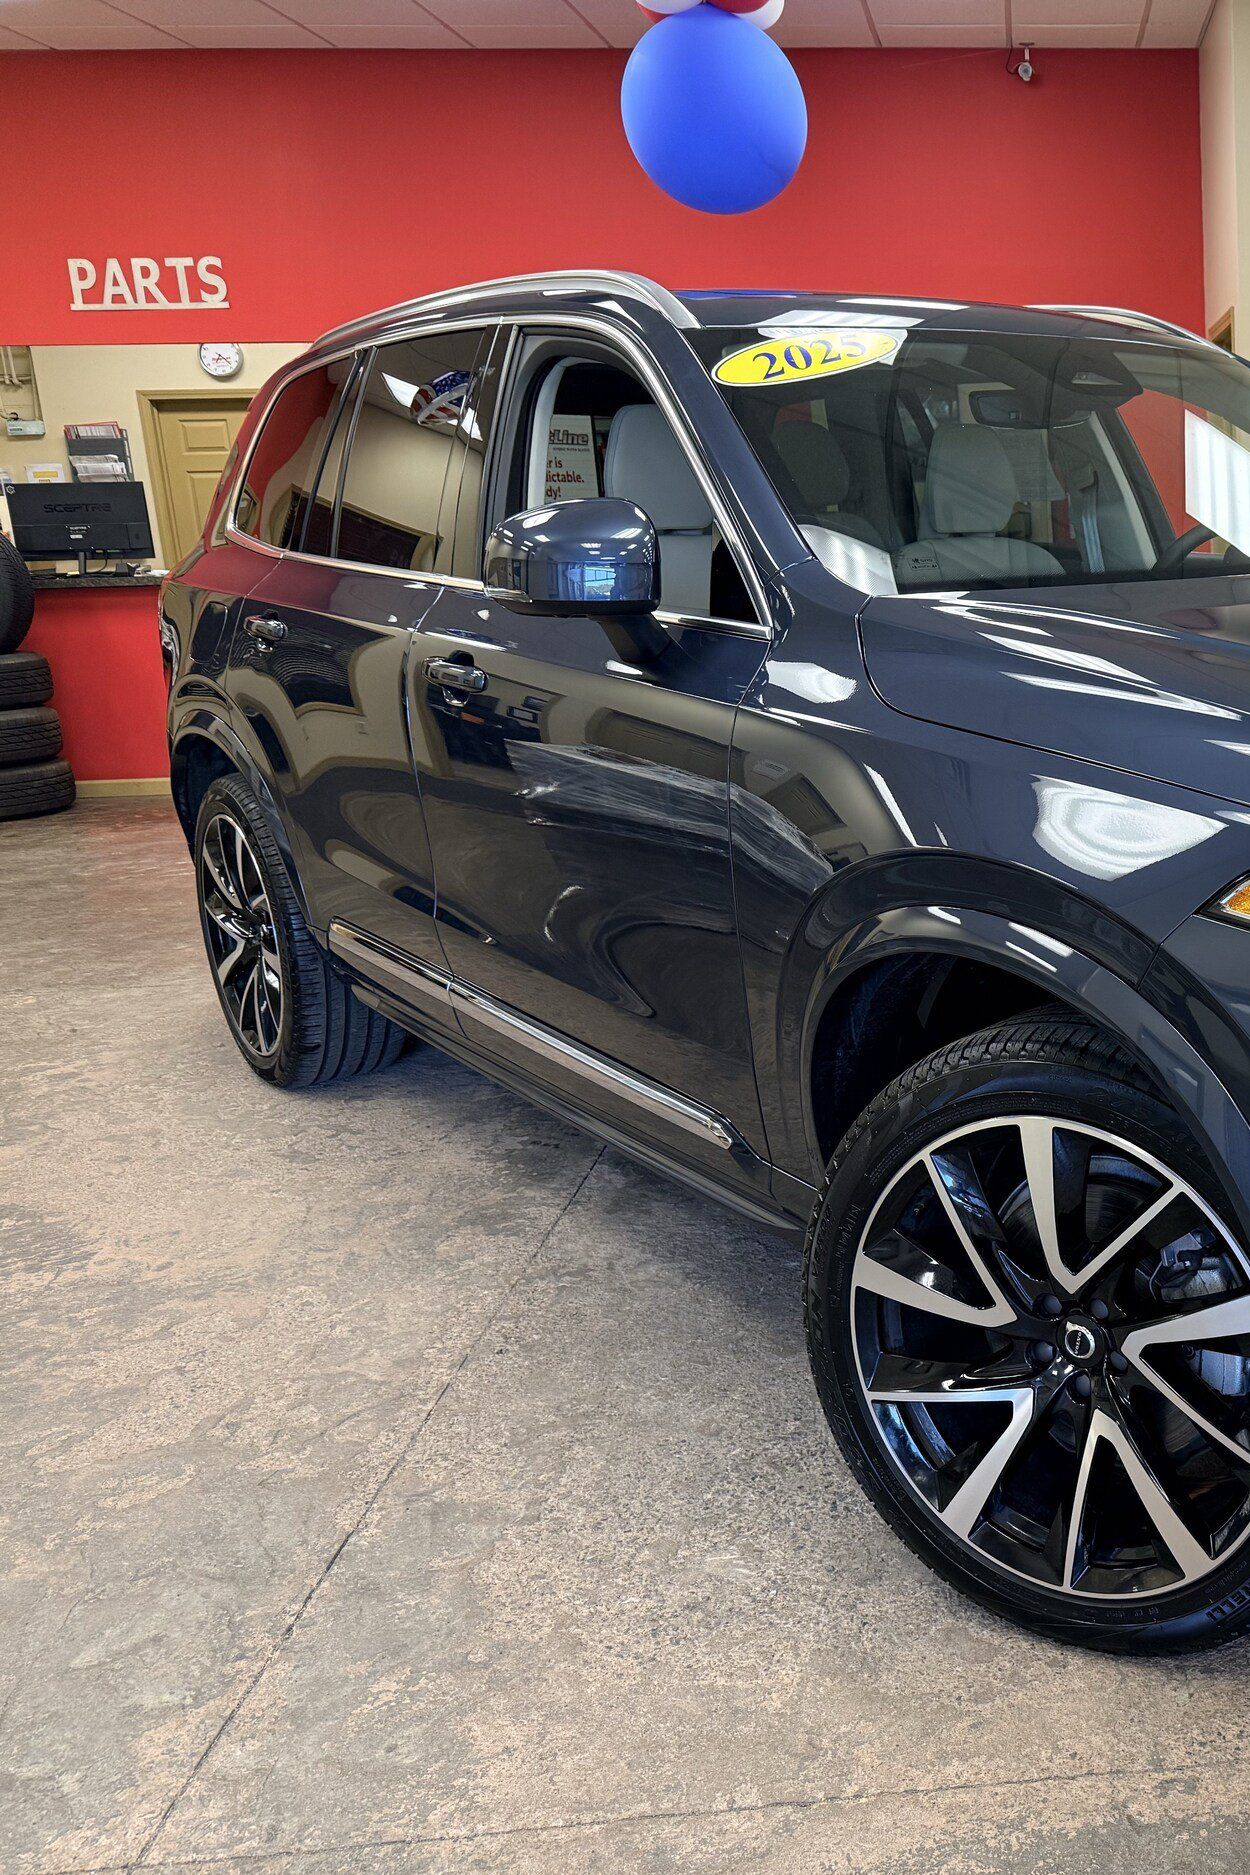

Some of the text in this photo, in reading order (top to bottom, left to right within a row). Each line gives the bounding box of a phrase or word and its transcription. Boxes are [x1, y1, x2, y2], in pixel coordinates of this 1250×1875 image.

[67, 255, 228, 305] PARTS
[752, 334, 866, 380] 2025
[554, 456, 563, 468] is
[43, 502, 112, 514] SCEPTRE
[1074, 1331, 1082, 1355] VOLVO
